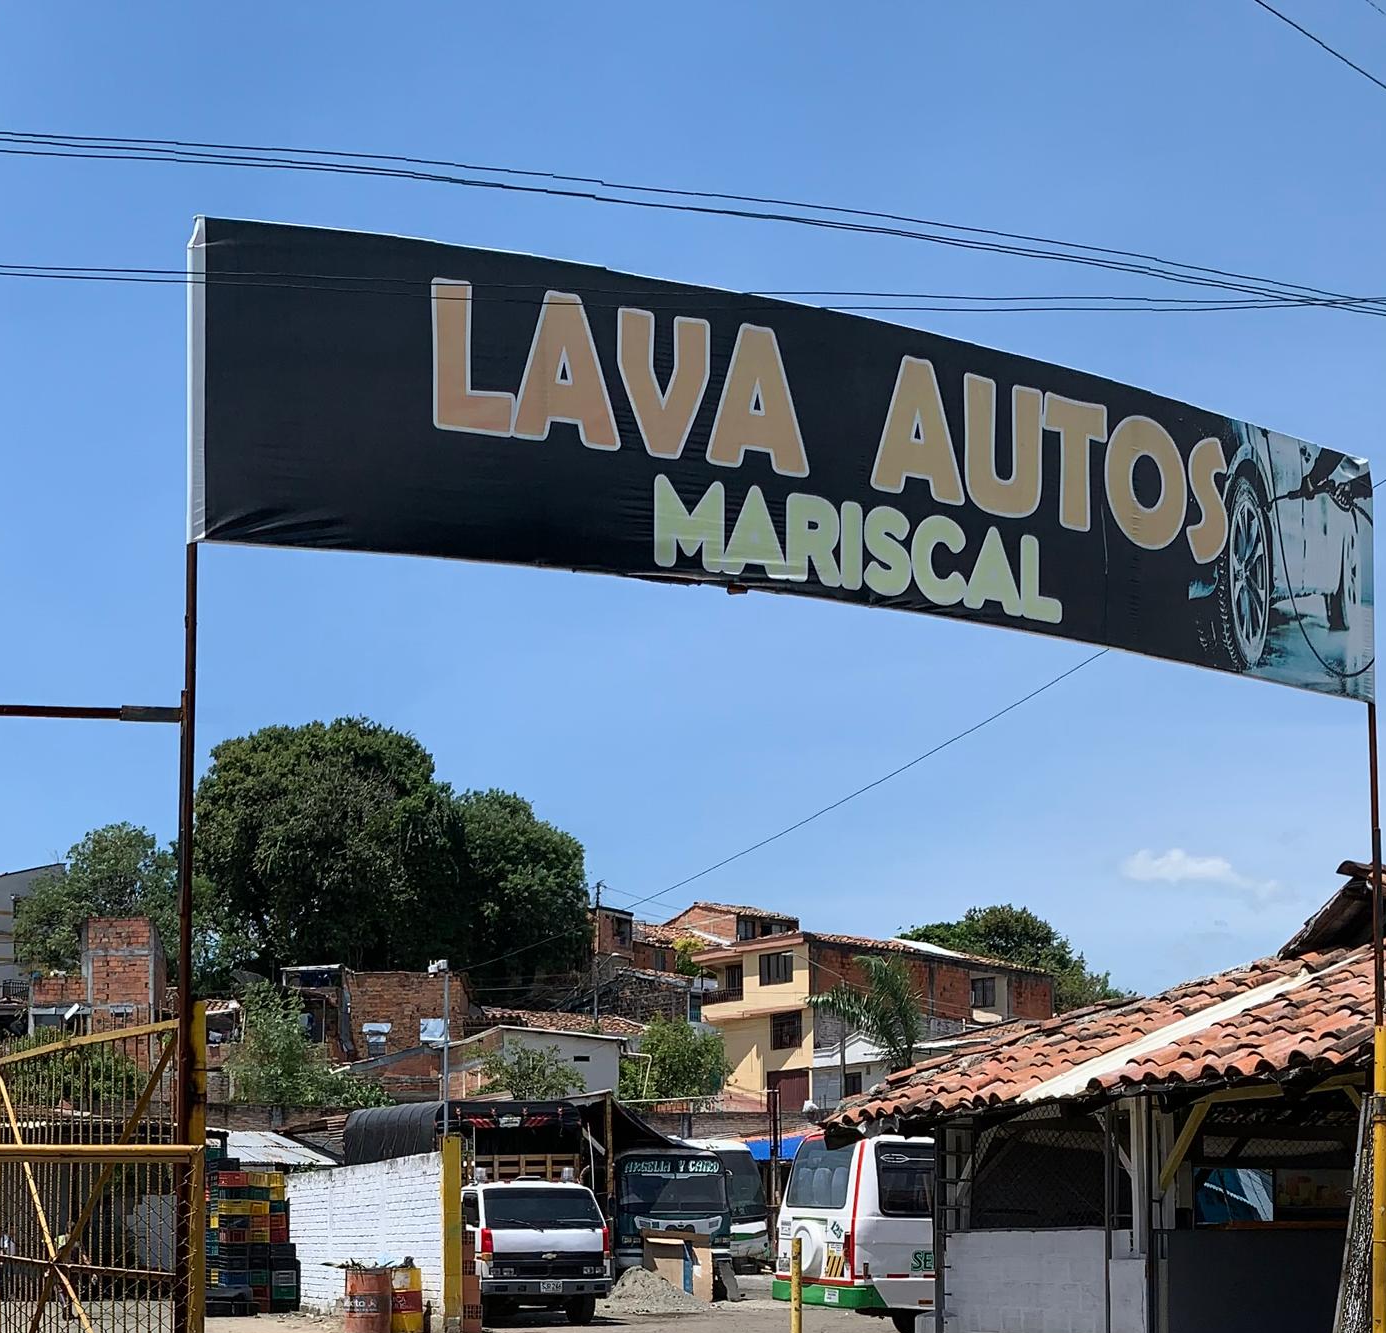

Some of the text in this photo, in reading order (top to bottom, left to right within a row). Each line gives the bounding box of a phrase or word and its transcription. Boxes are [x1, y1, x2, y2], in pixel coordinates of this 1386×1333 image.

[429, 277, 1228, 563] LAVA AUTOS
[653, 473, 1062, 624] MARISCAL
[830, 1220, 844, 1240] 125
